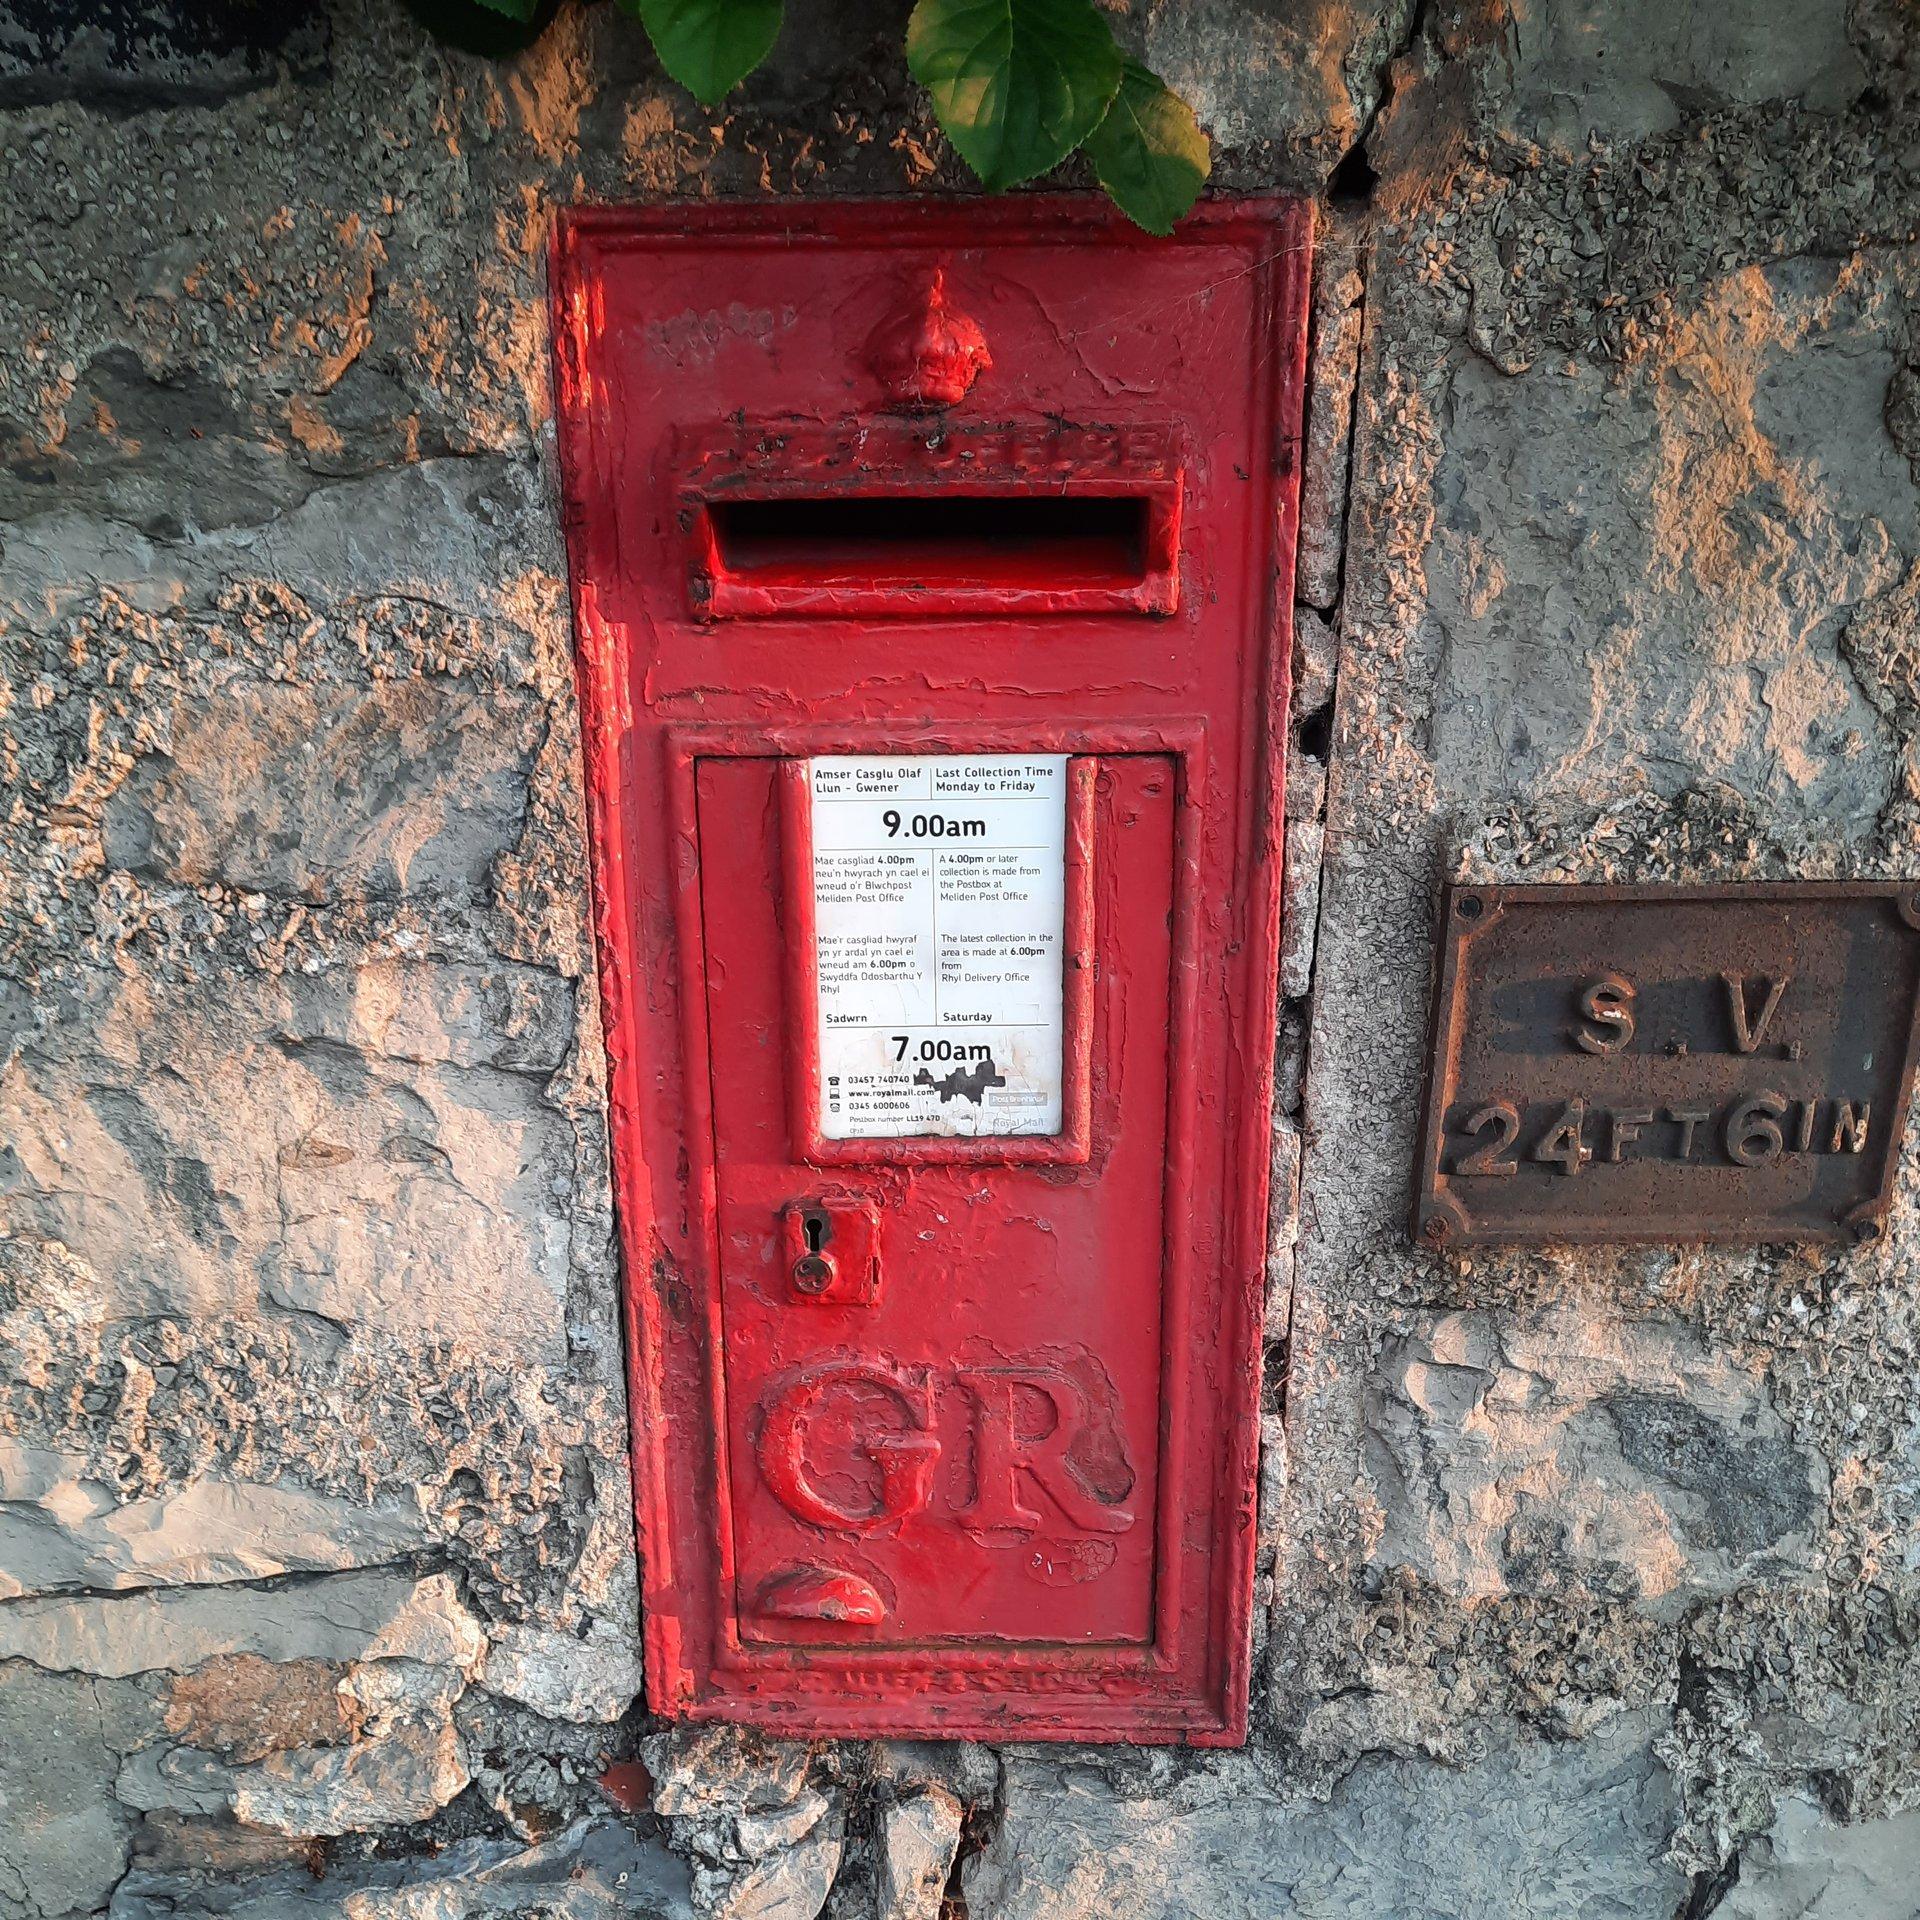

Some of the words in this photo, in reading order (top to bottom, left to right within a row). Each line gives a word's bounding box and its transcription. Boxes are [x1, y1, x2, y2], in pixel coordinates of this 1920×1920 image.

[815, 770, 851, 779] Amser
[856, 769, 893, 780] Casglu
[898, 769, 922, 778] Olaf
[936, 768, 960, 777] Last
[964, 768, 1020, 777] Collection
[1024, 767, 1053, 776] Time
[816, 784, 841, 792] Llun
[856, 783, 899, 792] Gwener
[936, 782, 980, 793] Monday
[985, 782, 995, 791] to
[1000, 781, 1035, 792] Friday
[883, 810, 986, 837] 9.00am
[815, 857, 834, 865] Mae
[838, 856, 875, 866] casgliad
[878, 856, 914, 865] 4.00pm
[939, 855, 945, 863] A
[949, 855, 983, 864] 4.00pm
[816, 869, 841, 877] neu'n
[844, 869, 882, 879] hwyrach
[886, 870, 896, 878] yn
[940, 867, 979, 876] collection
[982, 867, 989, 875] is
[993, 867, 1016, 875] made
[1020, 866, 1040, 875] from
[816, 882, 846, 890] wneud
[865, 881, 912, 890] Blwchpost
[957, 880, 990, 888] Postbox
[817, 894, 852, 902] Meliden
[856, 894, 876, 902] Post
[941, 893, 975, 901] Meliden
[980, 892, 999, 900] Post
[1003, 892, 1028, 900] Office
[819, 936, 843, 944] Mae'r
[847, 935, 882, 945] casgliad
[886, 935, 917, 945] hwyraf
[941, 934, 957, 942] The
[960, 934, 983, 942] latest
[986, 934, 1025, 942] collection
[833, 950, 841, 958] yr
[906, 947, 913, 955] ei
[973, 948, 996, 956] made
[1011, 947, 1045, 957] 6.00pm
[870, 960, 906, 969] 6.00pm
[820, 973, 857, 982] Swyddfa
[862, 972, 914, 980] Ddosbarthu
[942, 974, 961, 983] Rhyl
[965, 973, 1001, 983] Delivery
[1005, 973, 1029, 981] Office
[821, 985, 839, 994] Rhyl
[826, 1014, 867, 1023] Sadwrn
[943, 1012, 992, 1023] Saturday
[892, 1037, 991, 1062] 7.00am
[994, 1118, 1019, 1128] Royal
[1024, 1118, 1044, 1126] Mail
[756, 1358, 1136, 1534] GR
